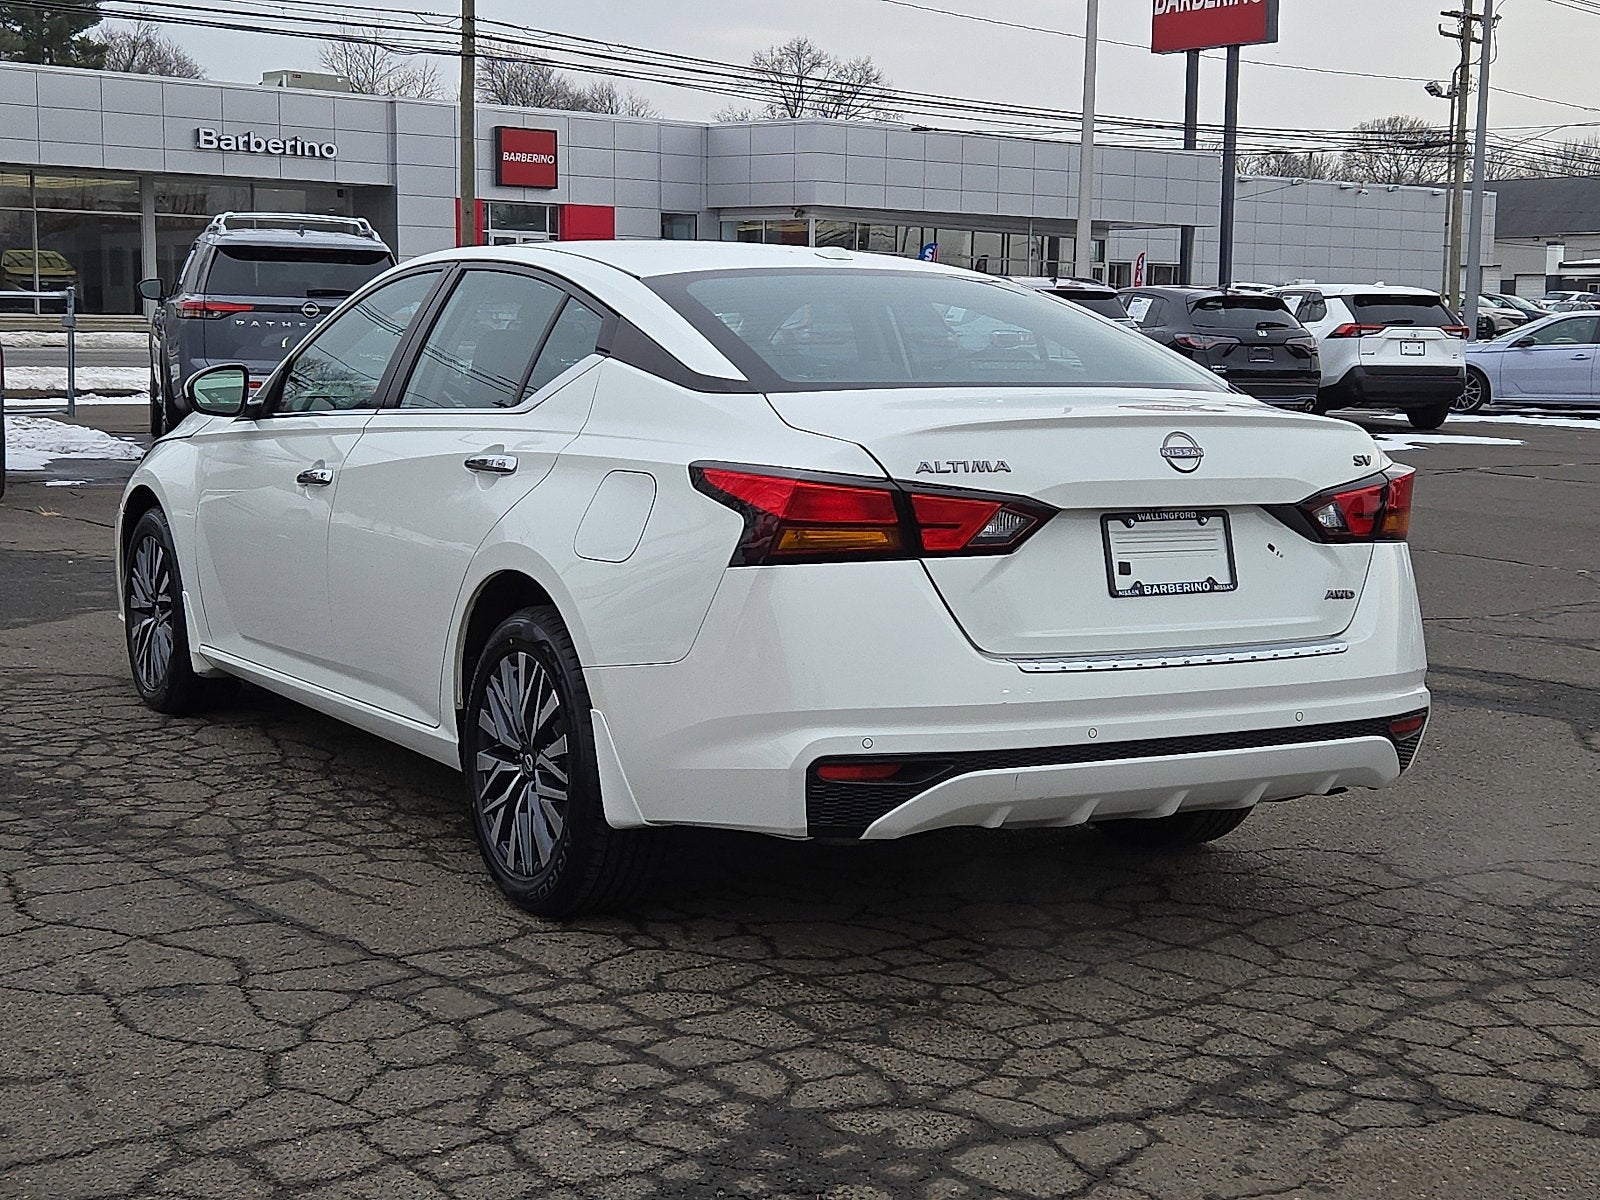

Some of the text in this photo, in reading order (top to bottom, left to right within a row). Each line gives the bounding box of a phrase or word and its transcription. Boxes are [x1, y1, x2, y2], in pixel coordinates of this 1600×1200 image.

[197, 127, 338, 159] Barberino
[502, 151, 555, 165] BARBERINO
[1161, 448, 1204, 457] NISSAN
[915, 460, 1011, 474] ALTIMA
[1353, 454, 1371, 467] SV
[1136, 511, 1197, 521] WALLINGFORD
[1143, 582, 1210, 595] BARBERINO
[1324, 589, 1355, 600] AWD
